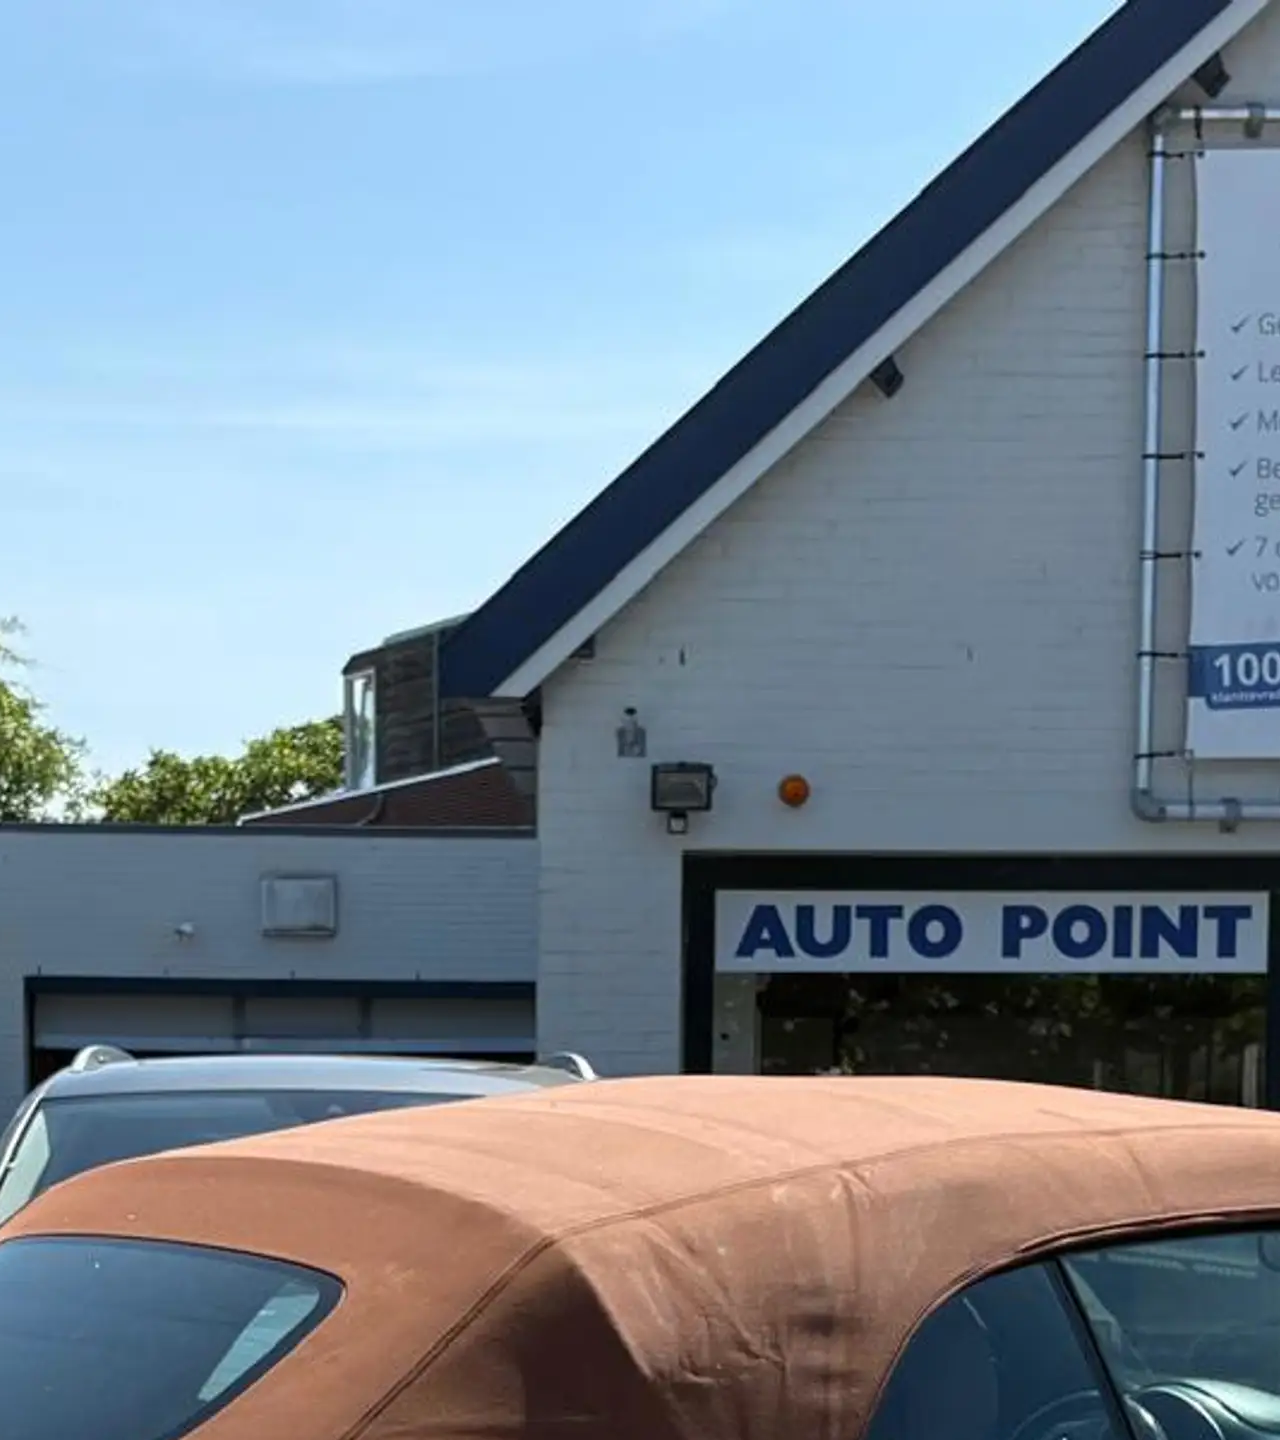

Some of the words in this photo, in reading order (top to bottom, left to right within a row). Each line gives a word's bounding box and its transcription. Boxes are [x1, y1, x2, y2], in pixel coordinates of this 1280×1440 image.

[1255, 538, 1269, 559] 7
[734, 903, 964, 960] AUTO
[1001, 904, 1253, 960] POINT
